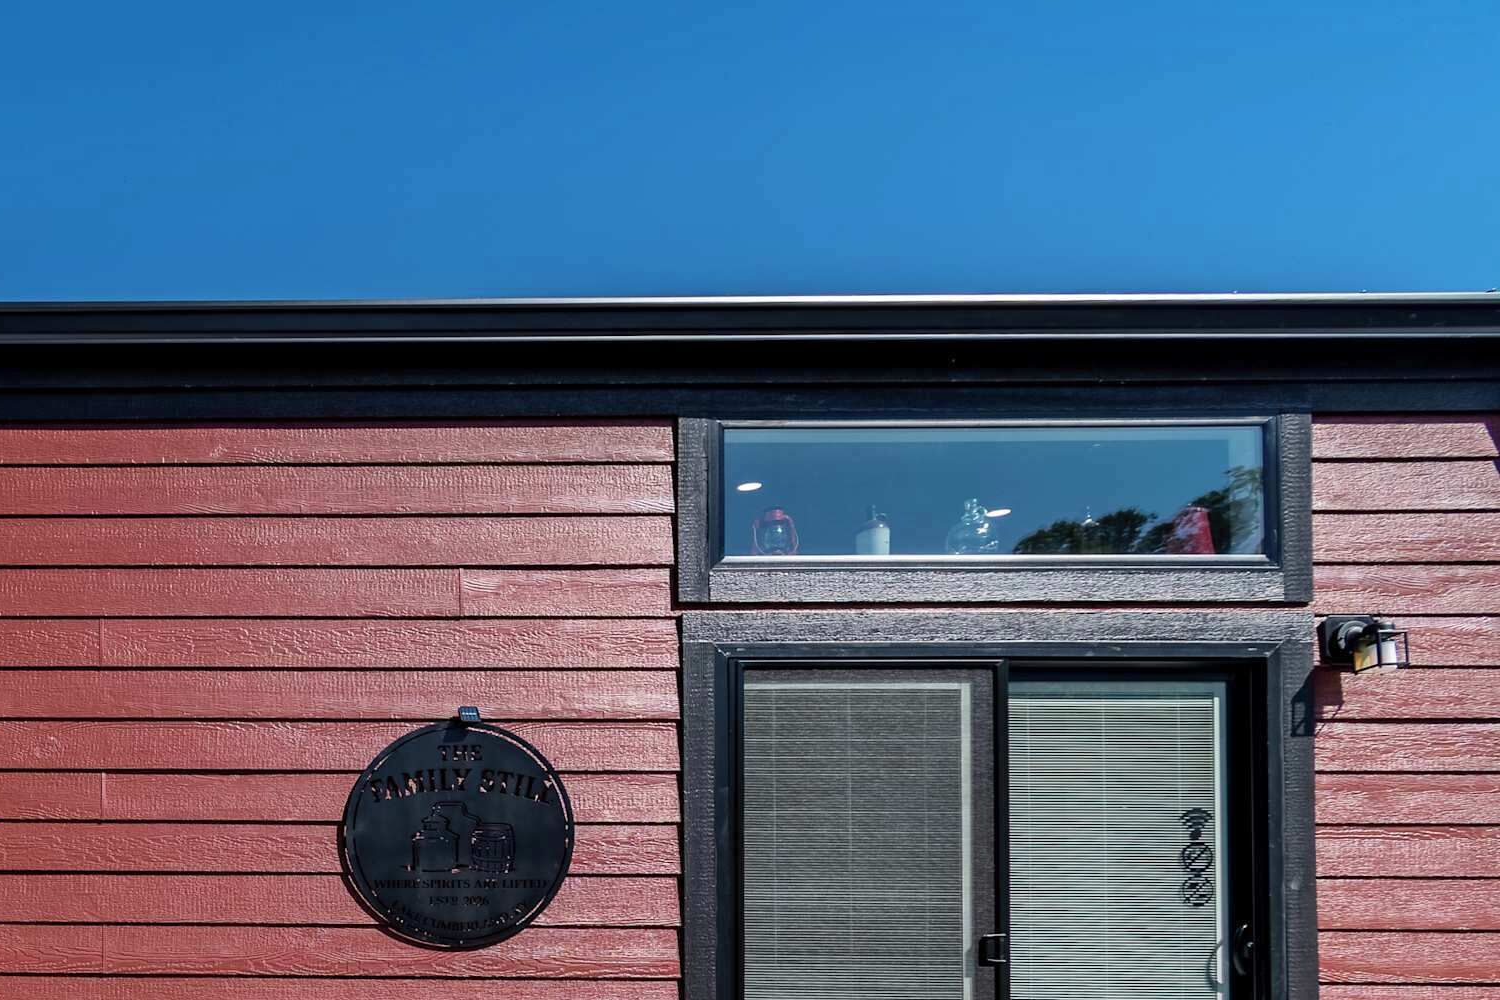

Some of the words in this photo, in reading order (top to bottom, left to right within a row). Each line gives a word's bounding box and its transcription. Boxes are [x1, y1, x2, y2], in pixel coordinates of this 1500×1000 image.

[437, 744, 483, 761] THE
[371, 768, 473, 802] FAMILY
[479, 768, 554, 805] STILL
[422, 879, 471, 889] SPIRITS
[502, 879, 549, 889] LIFTED
